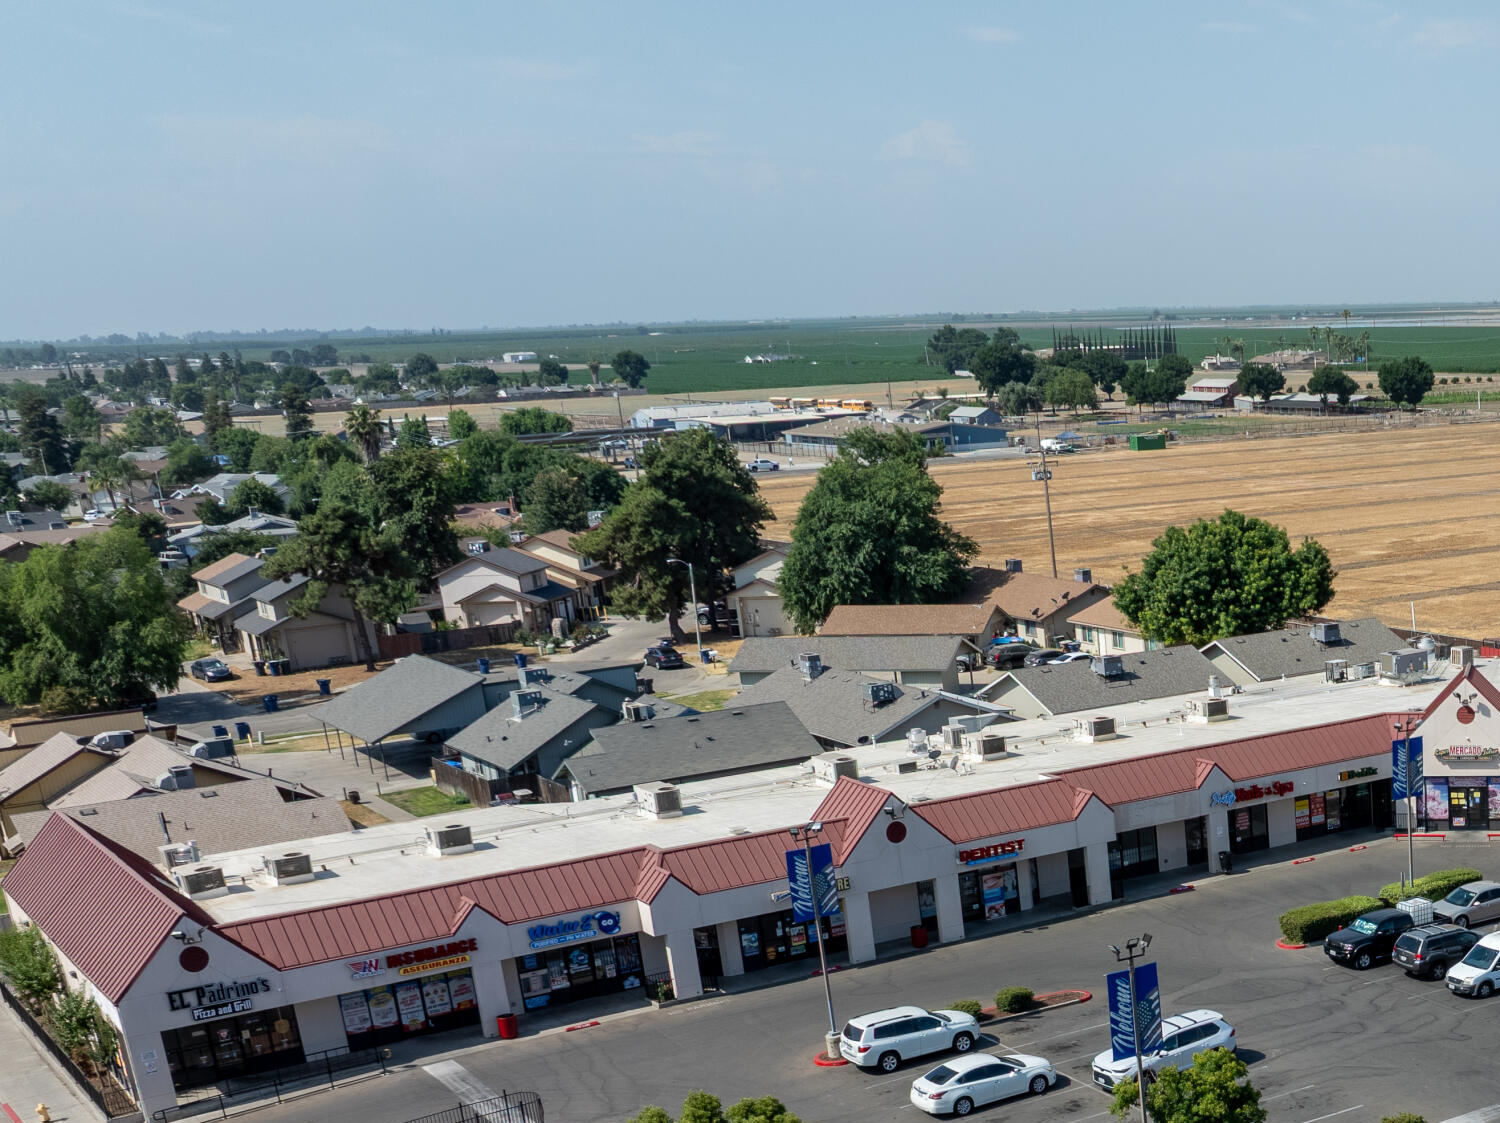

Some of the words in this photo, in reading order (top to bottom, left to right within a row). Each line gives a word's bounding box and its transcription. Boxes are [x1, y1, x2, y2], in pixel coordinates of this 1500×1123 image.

[1450, 746, 1482, 755] MERCADO
[1236, 785, 1264, 802] Nails
[1273, 781, 1294, 797] Spa
[960, 839, 1025, 862] DENTIST
[790, 853, 815, 917] Welcome
[601, 918, 614, 926] GO
[385, 938, 479, 969] INSURANCE
[402, 956, 468, 975] ASEGURANZA
[167, 990, 191, 1012] EL
[194, 977, 271, 1007] Padrino's
[193, 1008, 216, 1020] Pizza
[218, 1003, 233, 1015] and
[233, 999, 252, 1011] Grill
[1110, 977, 1135, 1053] Welcome
